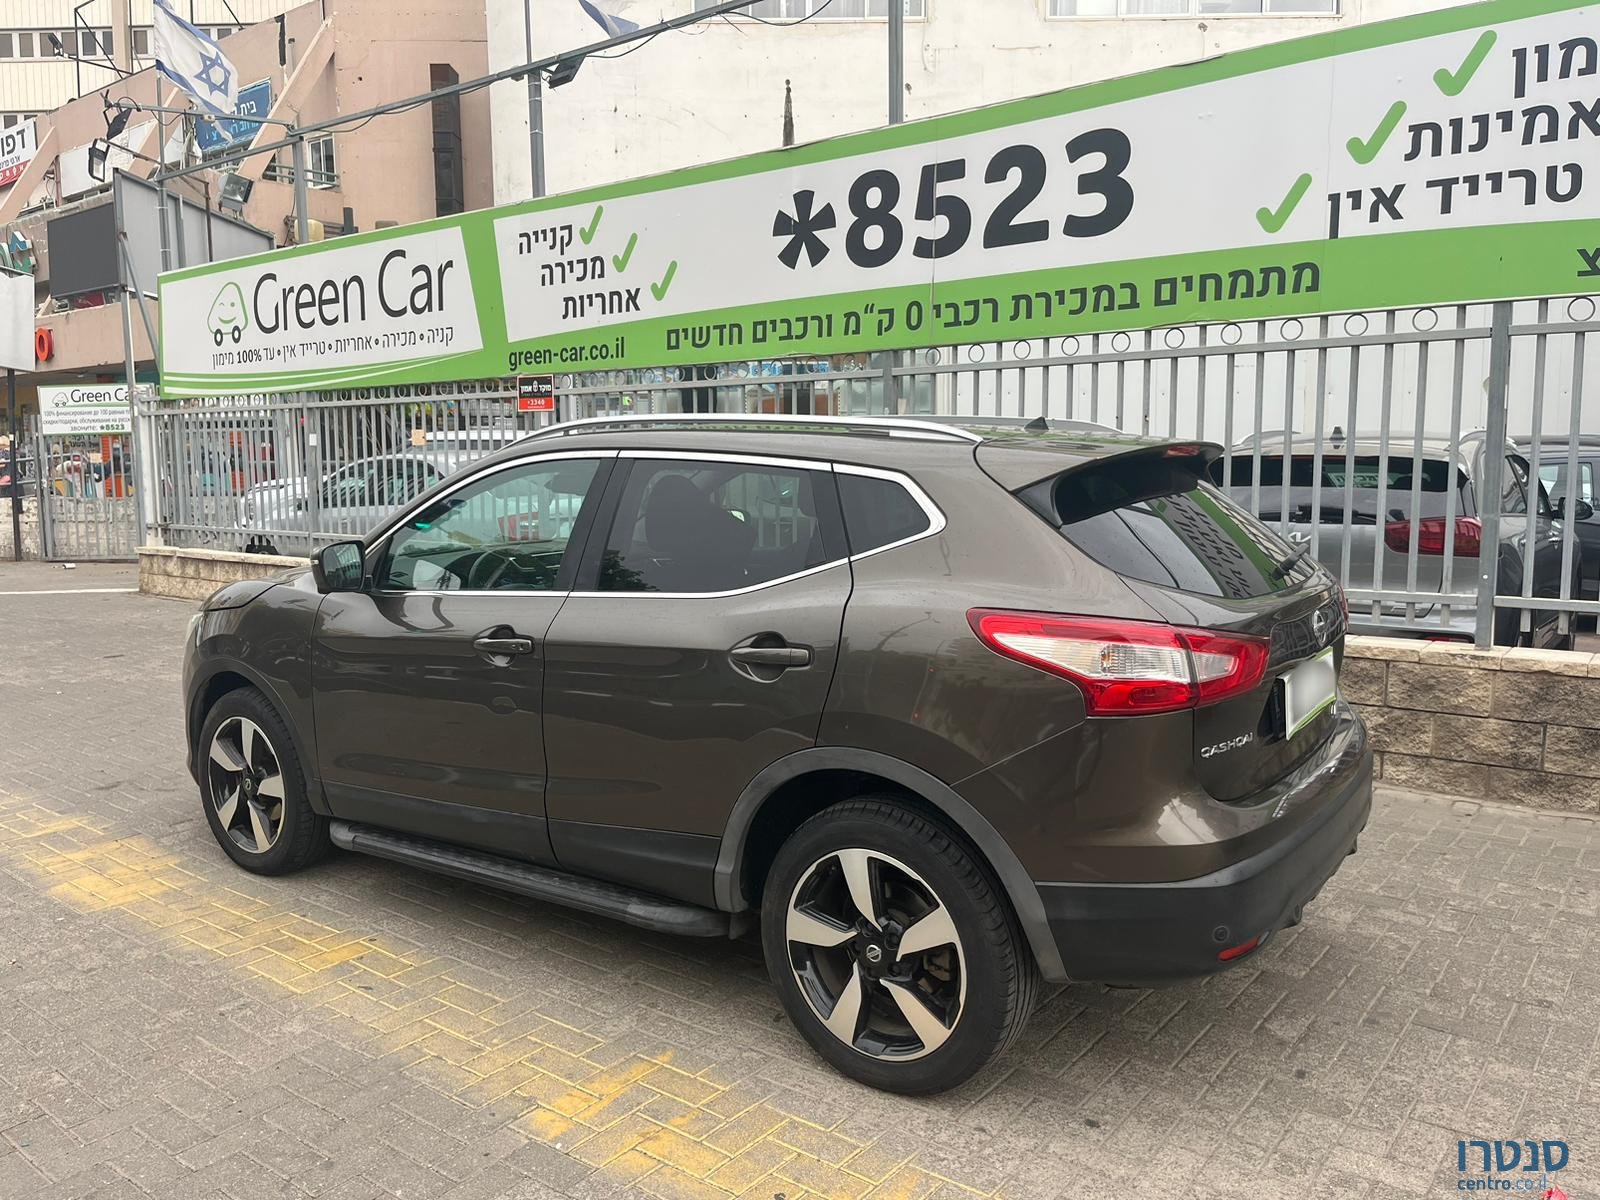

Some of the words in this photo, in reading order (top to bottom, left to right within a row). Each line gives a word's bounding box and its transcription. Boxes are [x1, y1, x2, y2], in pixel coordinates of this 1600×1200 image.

[1425, 162, 1583, 215] טרייד
[1328, 183, 1407, 240] אין
[518, 224, 573, 255] קנייה
[541, 256, 605, 286] מכירה
[1153, 261, 1320, 307] מתמחים
[253, 272, 366, 334] Green
[378, 249, 454, 318] Car
[562, 287, 641, 320] אחריות
[1009, 282, 1141, 322] במכירת
[905, 301, 923, 331] 0
[932, 297, 999, 329] רכבי
[382, 330, 417, 348] מכירה
[427, 326, 454, 347] קניה
[666, 322, 743, 351] חדשים
[752, 313, 833, 344] ורכבים
[236, 349, 262, 364] 100%
[262, 347, 275, 361] עד
[282, 344, 297, 363] אין
[299, 340, 326, 357] טרייד
[334, 335, 373, 354] אחריות
[508, 336, 625, 372] green-car.co.il
[212, 352, 234, 370] מימון
[70, 389, 112, 403] Green
[1200, 732, 1253, 758] QASHQAI
